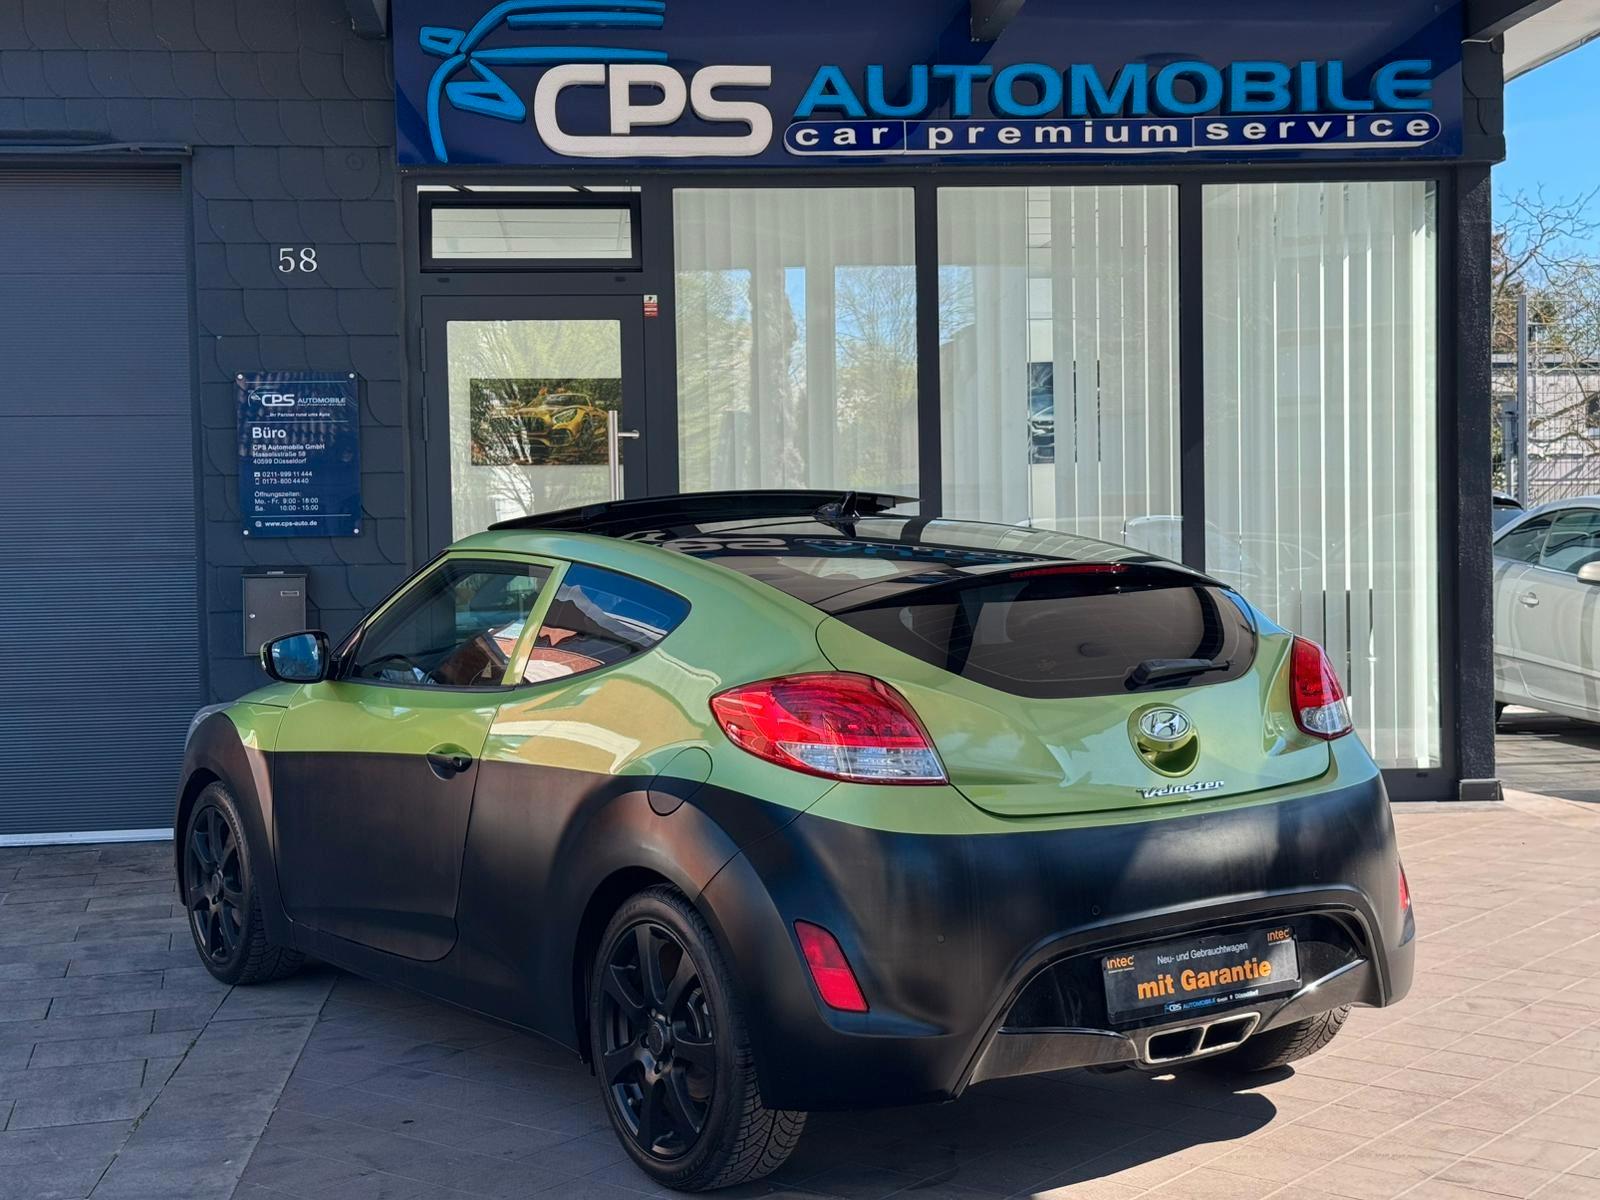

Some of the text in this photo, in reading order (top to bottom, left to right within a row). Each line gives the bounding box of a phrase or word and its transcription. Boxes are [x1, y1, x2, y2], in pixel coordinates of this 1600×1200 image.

[534, 59, 1433, 157] CPS AUTOMOBILE
[795, 115, 1430, 149] car premium service
[279, 247, 317, 272] 58
[261, 394, 295, 406] CPS
[252, 427, 287, 438] Büro
[264, 520, 318, 528] www.cps-auto.de
[1266, 927, 1290, 942] intec
[1106, 955, 1135, 969] intec
[1157, 942, 1249, 965] Neu- und Gebrauchtwagen
[1137, 957, 1272, 1000] mit Garantie
